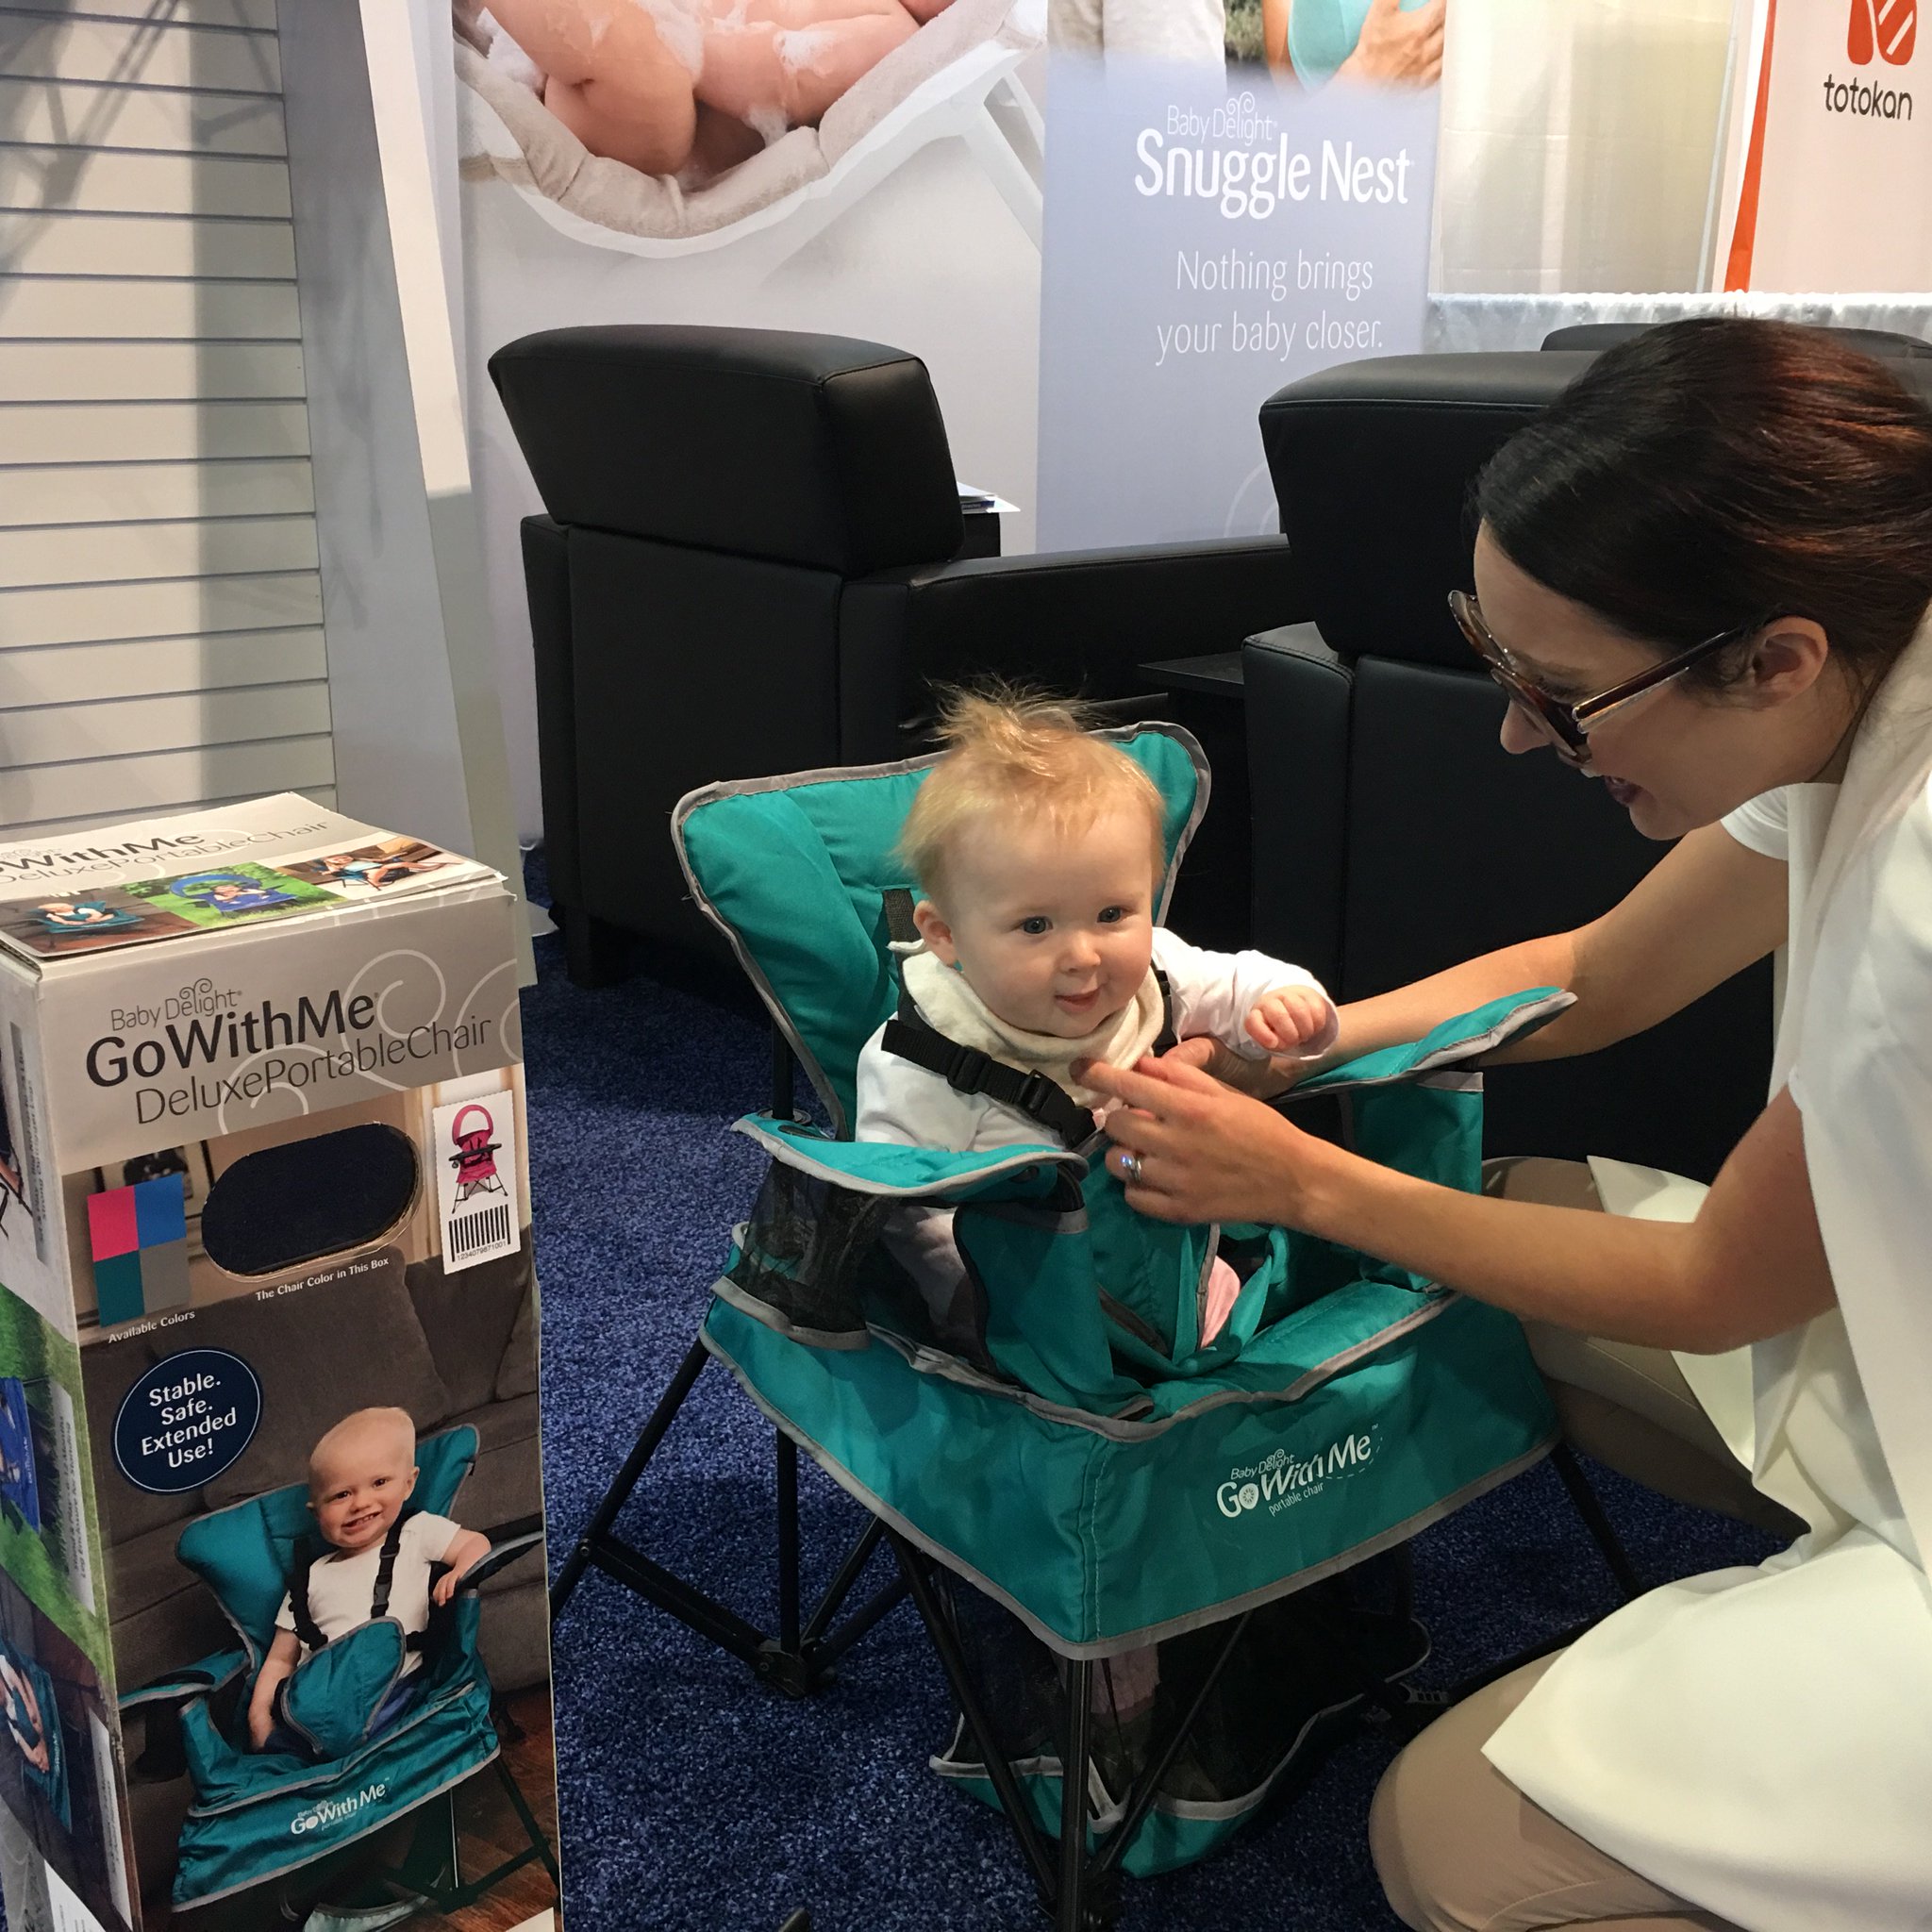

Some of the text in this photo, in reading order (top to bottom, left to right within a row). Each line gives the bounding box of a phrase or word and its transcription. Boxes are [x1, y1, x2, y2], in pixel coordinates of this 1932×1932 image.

[1167, 92, 1274, 146] Baby Delight
[1824, 74, 1913, 121] totokan
[1135, 128, 1410, 220] Snuggle Nest
[1177, 248, 1374, 302] Nothing brings
[1156, 310, 1383, 367] your baby closer.
[111, 978, 238, 1031] Baby Delight
[86, 990, 375, 1087] GoWithMe
[136, 1015, 491, 1124] DeluxePortableChair
[256, 1257, 390, 1302] The Chair Color in This Box
[108, 1309, 195, 1344] Available Colors
[149, 1373, 221, 1407] Stable.
[161, 1398, 213, 1425] Safe.
[142, 1407, 237, 1456] Extended
[168, 1438, 213, 1468] Use!
[1230, 1448, 1295, 1480] Baby Delight
[1268, 1482, 1324, 1517] portable chair
